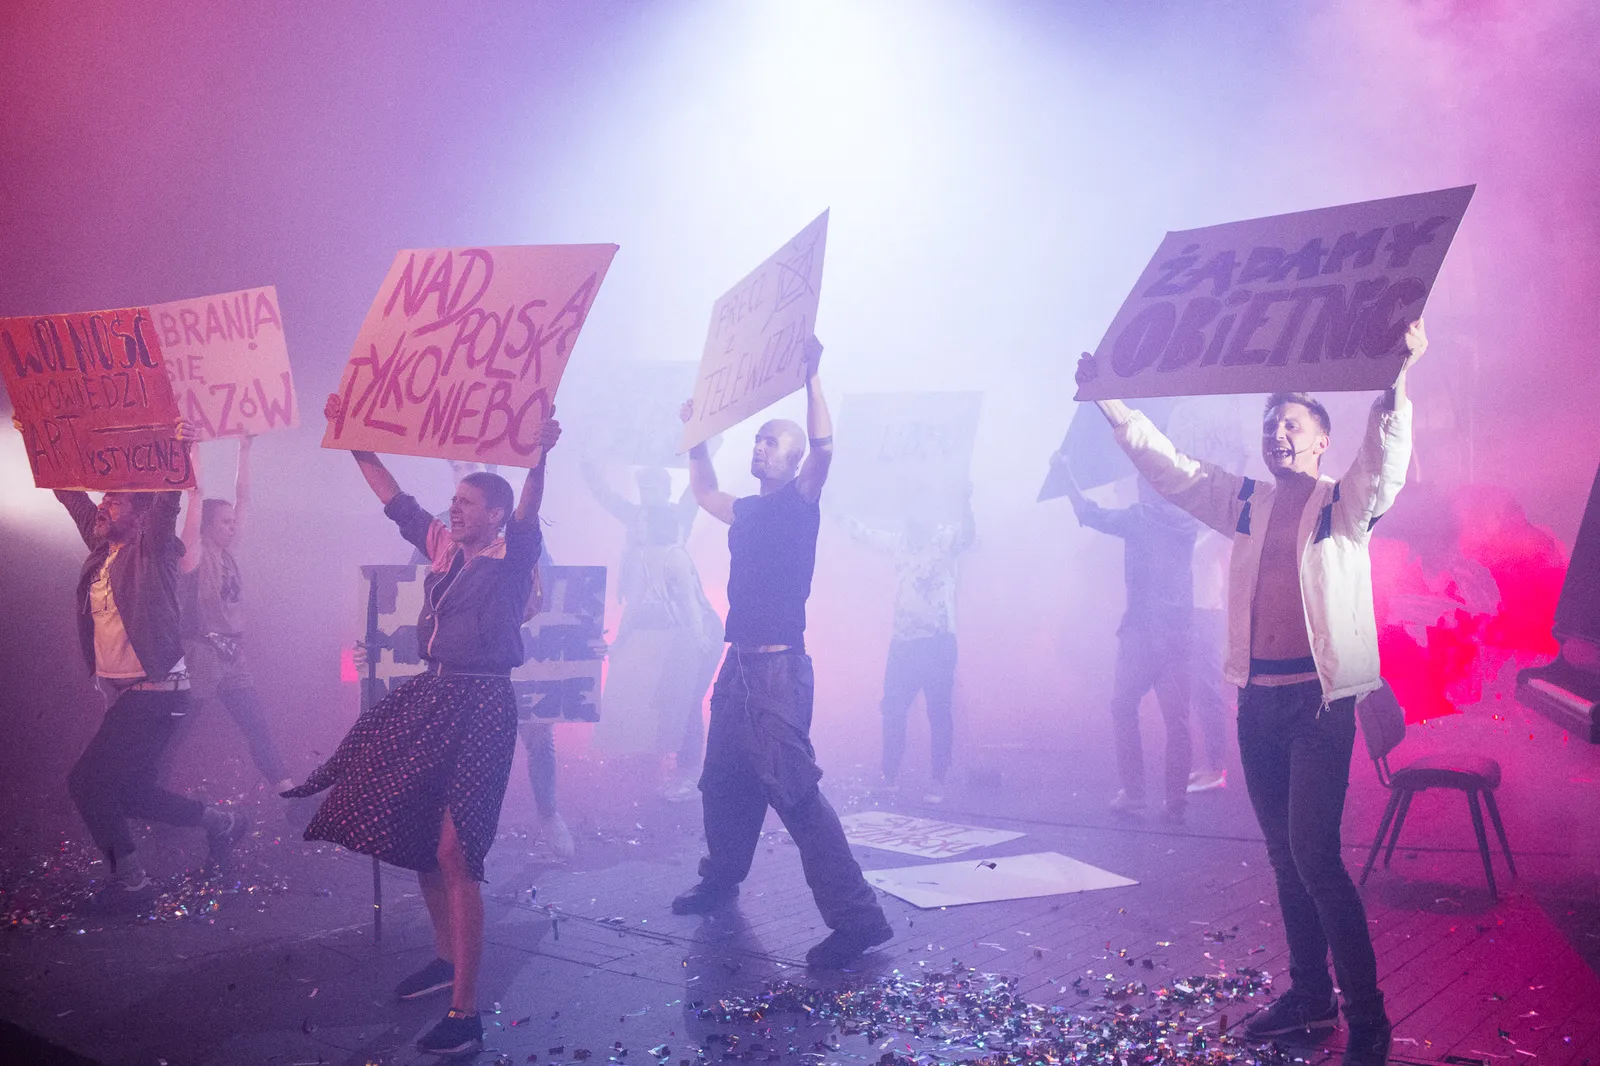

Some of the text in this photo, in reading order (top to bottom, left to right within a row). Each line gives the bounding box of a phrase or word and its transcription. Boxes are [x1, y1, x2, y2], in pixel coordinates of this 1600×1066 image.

[382, 248, 494, 338] NAD
[1, 308, 159, 378] WOLNOŚĆ
[177, 370, 292, 438] AZÓW
[333, 330, 443, 441] TYLKO
[417, 379, 549, 457] NIEBO
